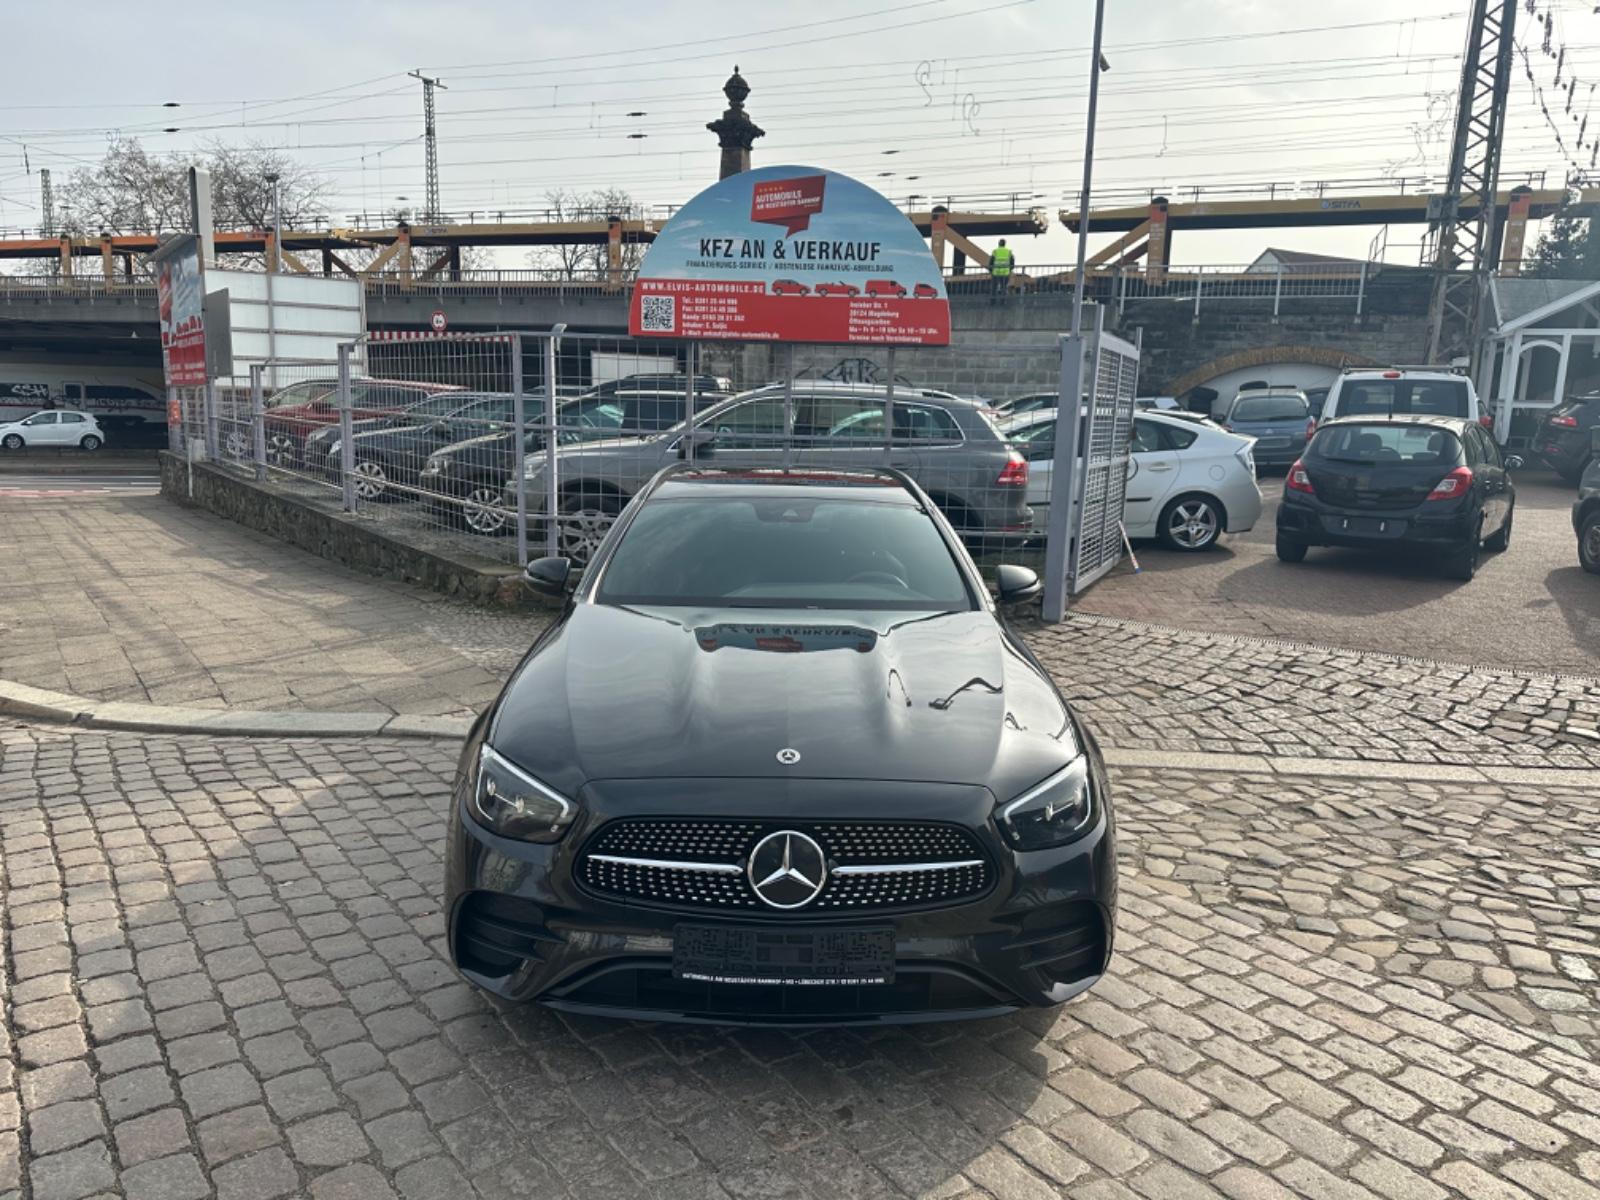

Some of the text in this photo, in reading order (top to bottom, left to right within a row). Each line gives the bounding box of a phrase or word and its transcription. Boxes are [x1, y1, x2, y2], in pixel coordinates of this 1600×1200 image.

[756, 190, 802, 203] AUTOMOBILE
[699, 239, 881, 261] KFZ AN & VERKAUF
